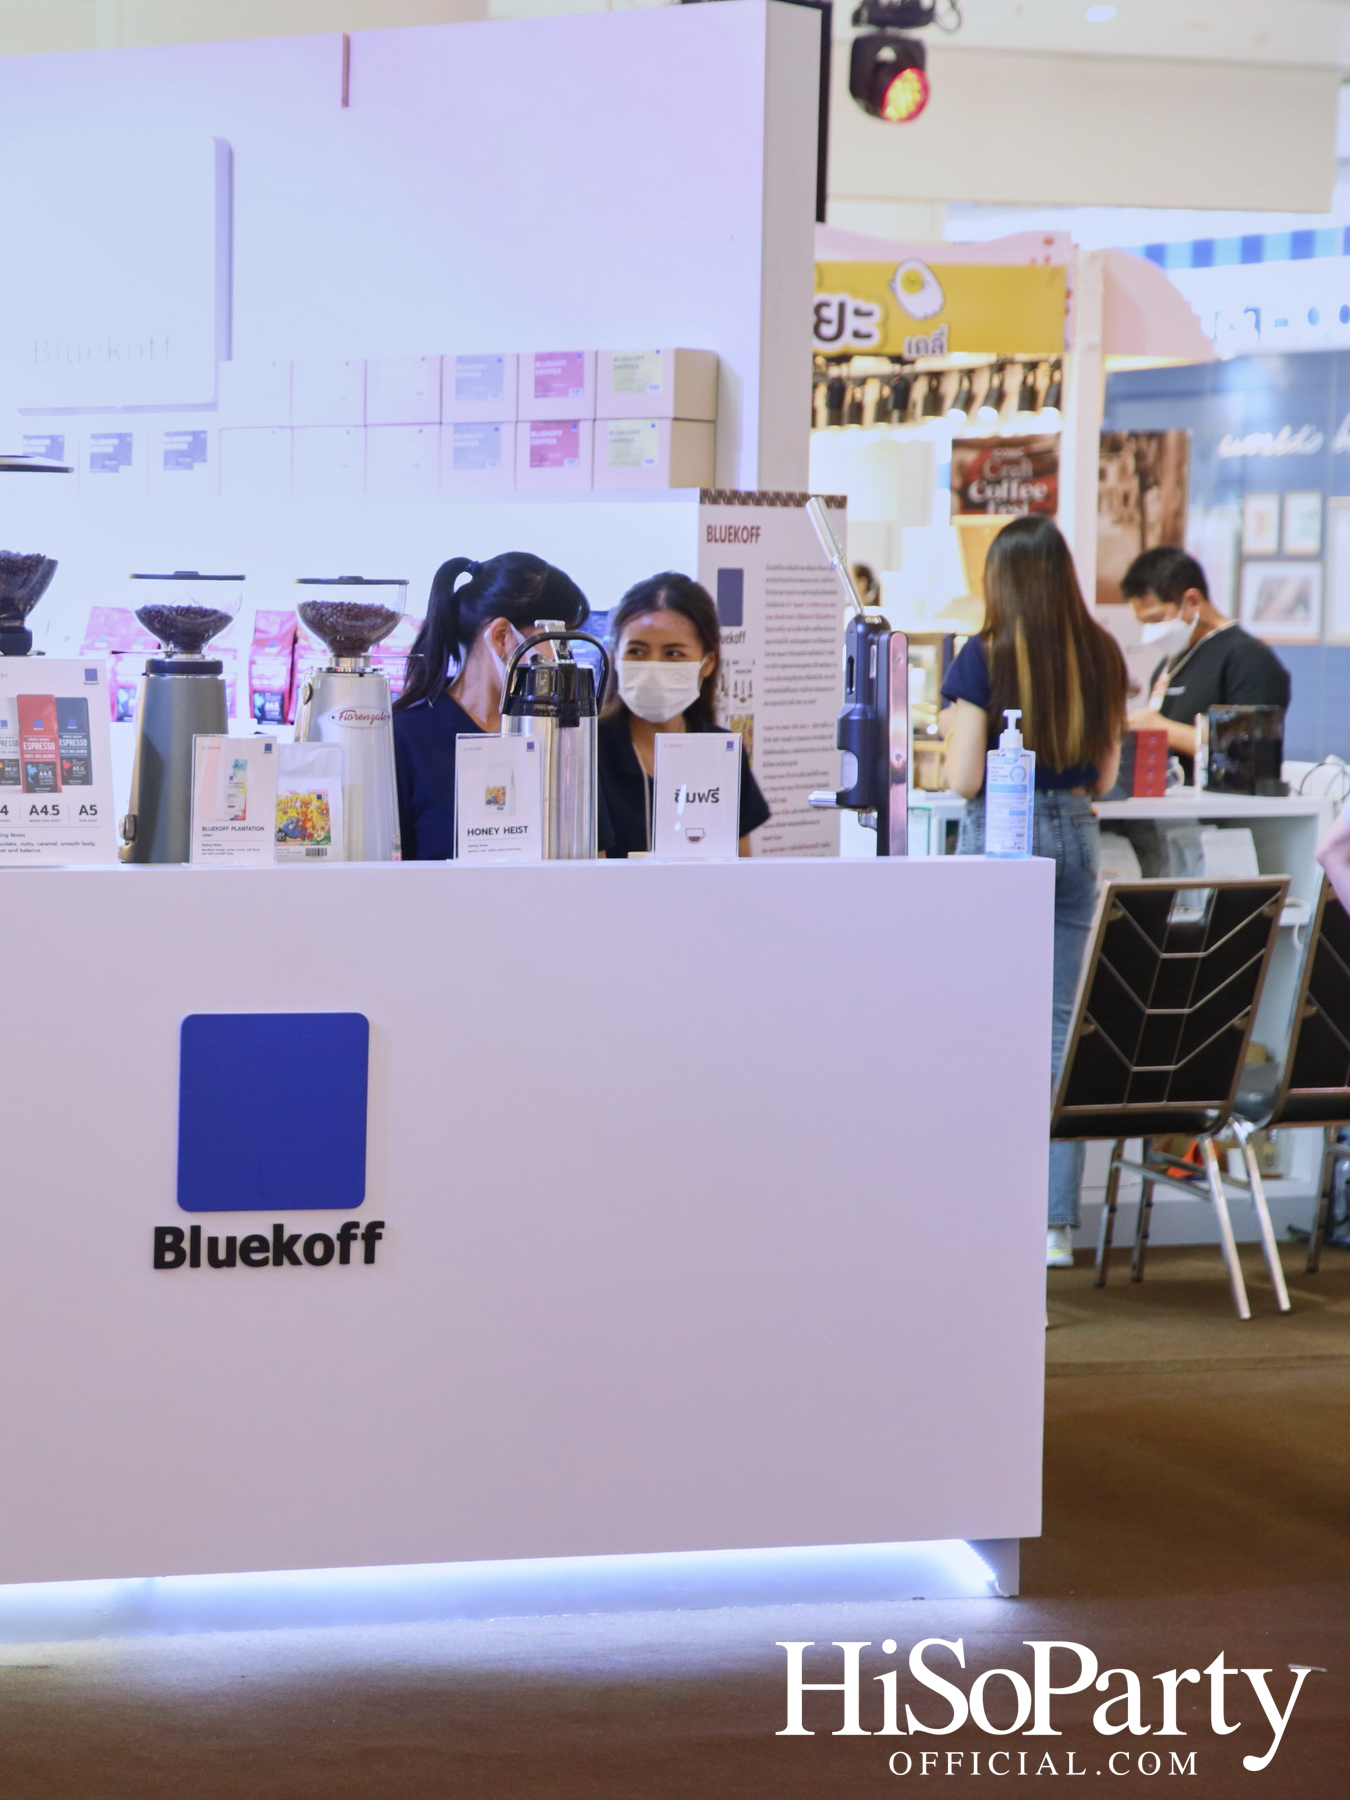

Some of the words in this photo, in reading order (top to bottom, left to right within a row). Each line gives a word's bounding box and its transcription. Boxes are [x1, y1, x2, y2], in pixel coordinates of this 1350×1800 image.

[34, 333, 171, 365] Bluekoff
[967, 479, 1049, 504] Coffee
[706, 524, 761, 544] BLUEKOFF
[720, 630, 747, 645] uekoff
[23, 741, 56, 751] ESPRESSO
[59, 738, 88, 747] ESPRESSO
[29, 804, 60, 816] A4.5
[78, 804, 98, 816] A5
[467, 827, 500, 837] HONEY
[503, 825, 529, 835] HEIST
[153, 1220, 386, 1270] Bluekoff
